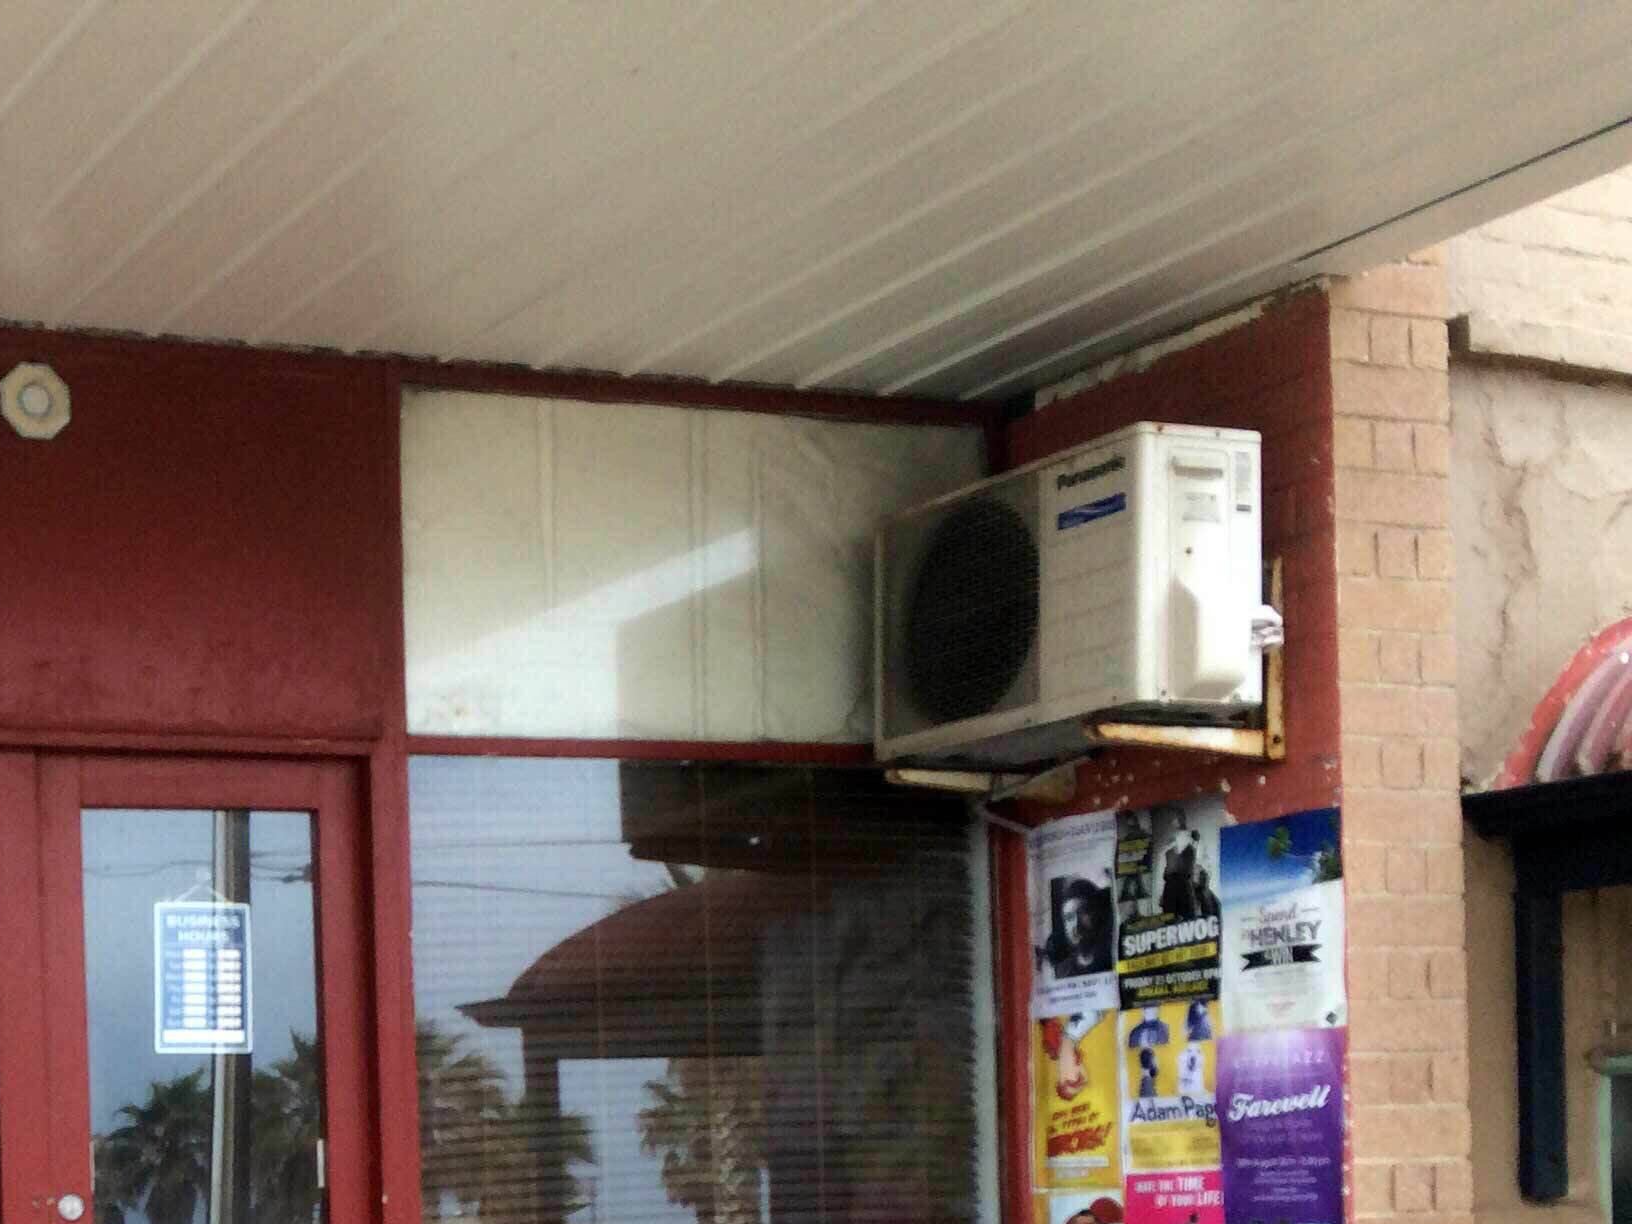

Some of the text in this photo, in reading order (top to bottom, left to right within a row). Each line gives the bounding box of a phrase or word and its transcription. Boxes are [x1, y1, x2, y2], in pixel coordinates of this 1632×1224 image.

[1123, 915, 1219, 957] SUPERWOG
[1249, 920, 1322, 947] HENLEY
[1130, 1098, 1181, 1122] Adam
[1181, 1095, 1217, 1129] Pag
[1228, 1084, 1331, 1122] Farewell
[1177, 1176, 1205, 1191] TIME
